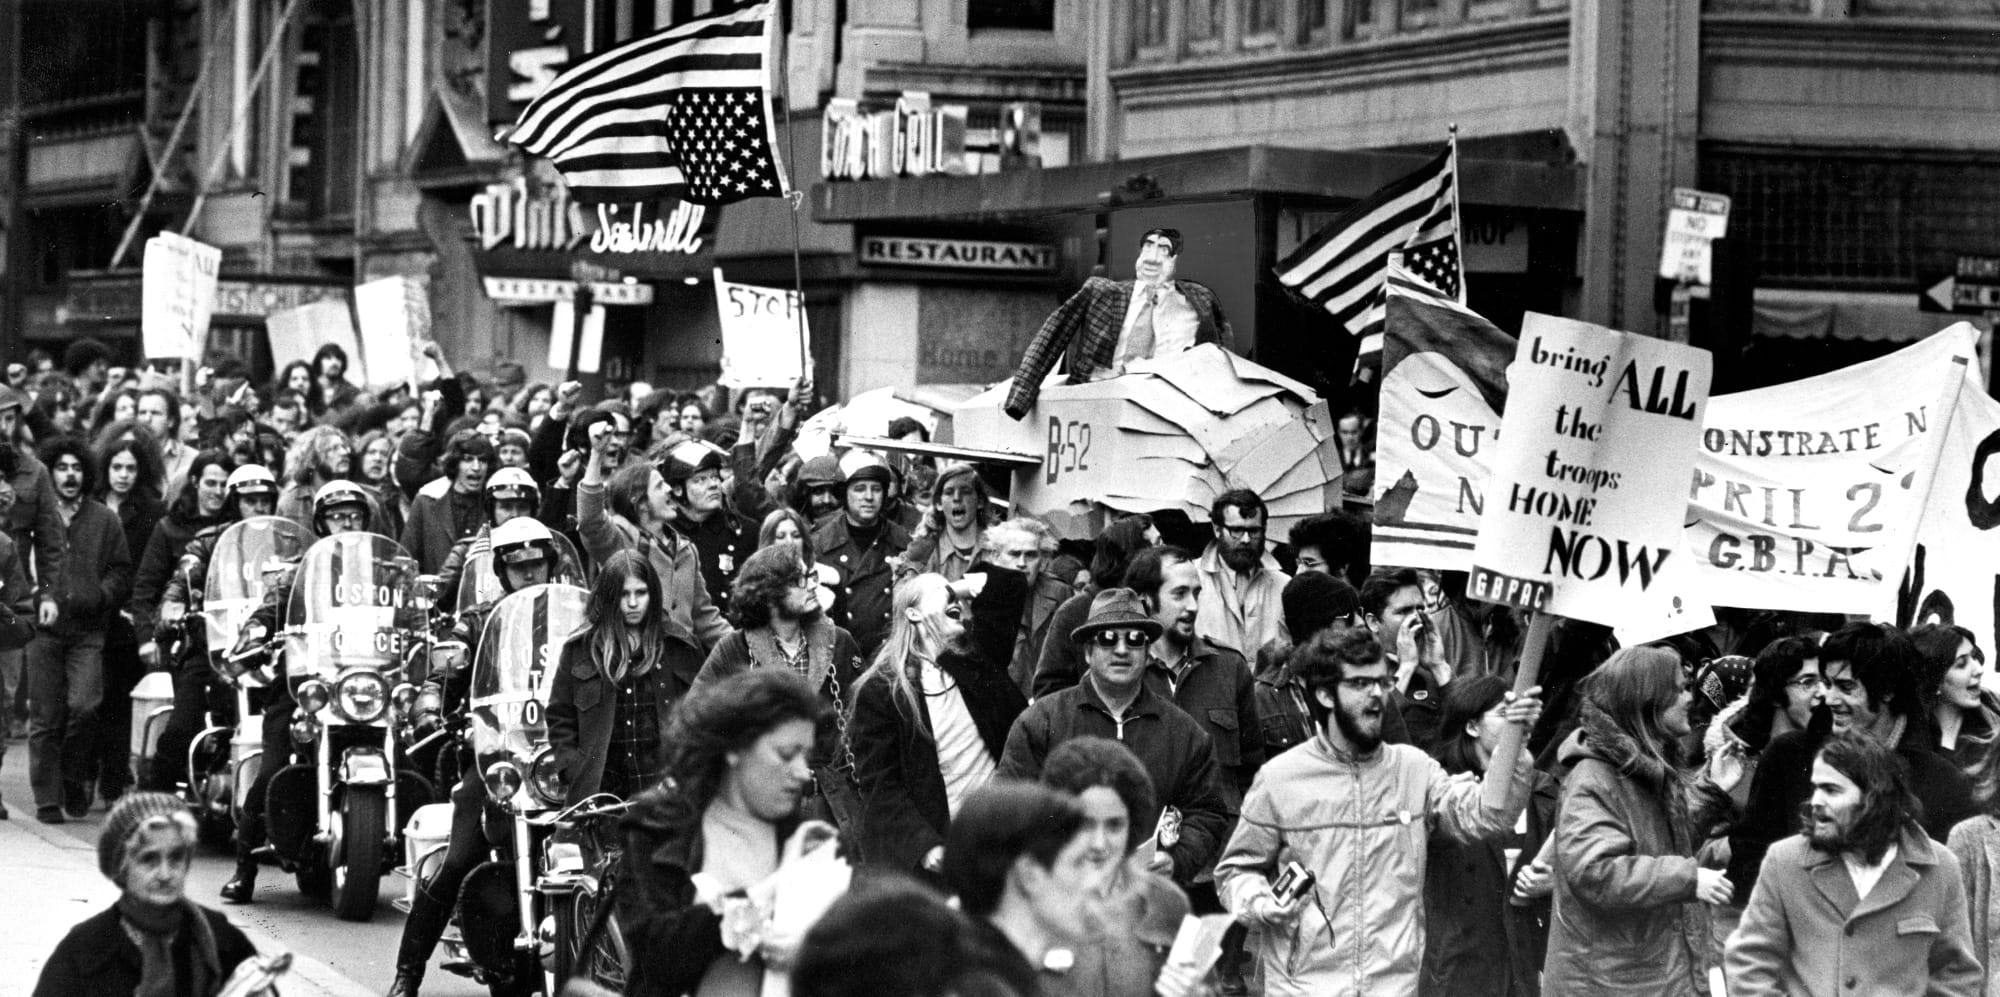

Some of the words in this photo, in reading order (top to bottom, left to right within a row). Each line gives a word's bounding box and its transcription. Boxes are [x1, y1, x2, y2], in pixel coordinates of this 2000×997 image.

[1686, 216, 1707, 232] NO
[867, 240, 1052, 269] RESTAURANT
[498, 281, 643, 300] RESTAANT
[727, 286, 801, 319] STOP
[1530, 336, 1611, 388] bring
[1608, 358, 1696, 421] ALL
[1411, 413, 1500, 458] OU
[1555, 404, 1602, 442] the
[1703, 422, 1882, 457] ONSTRATE
[1046, 415, 1091, 486] B-52
[1545, 450, 1622, 493] troops
[1508, 482, 1598, 527] HOME
[1689, 467, 1821, 531] PRIL
[1542, 525, 1672, 592] NOW
[1475, 572, 1547, 609] GBPAC
